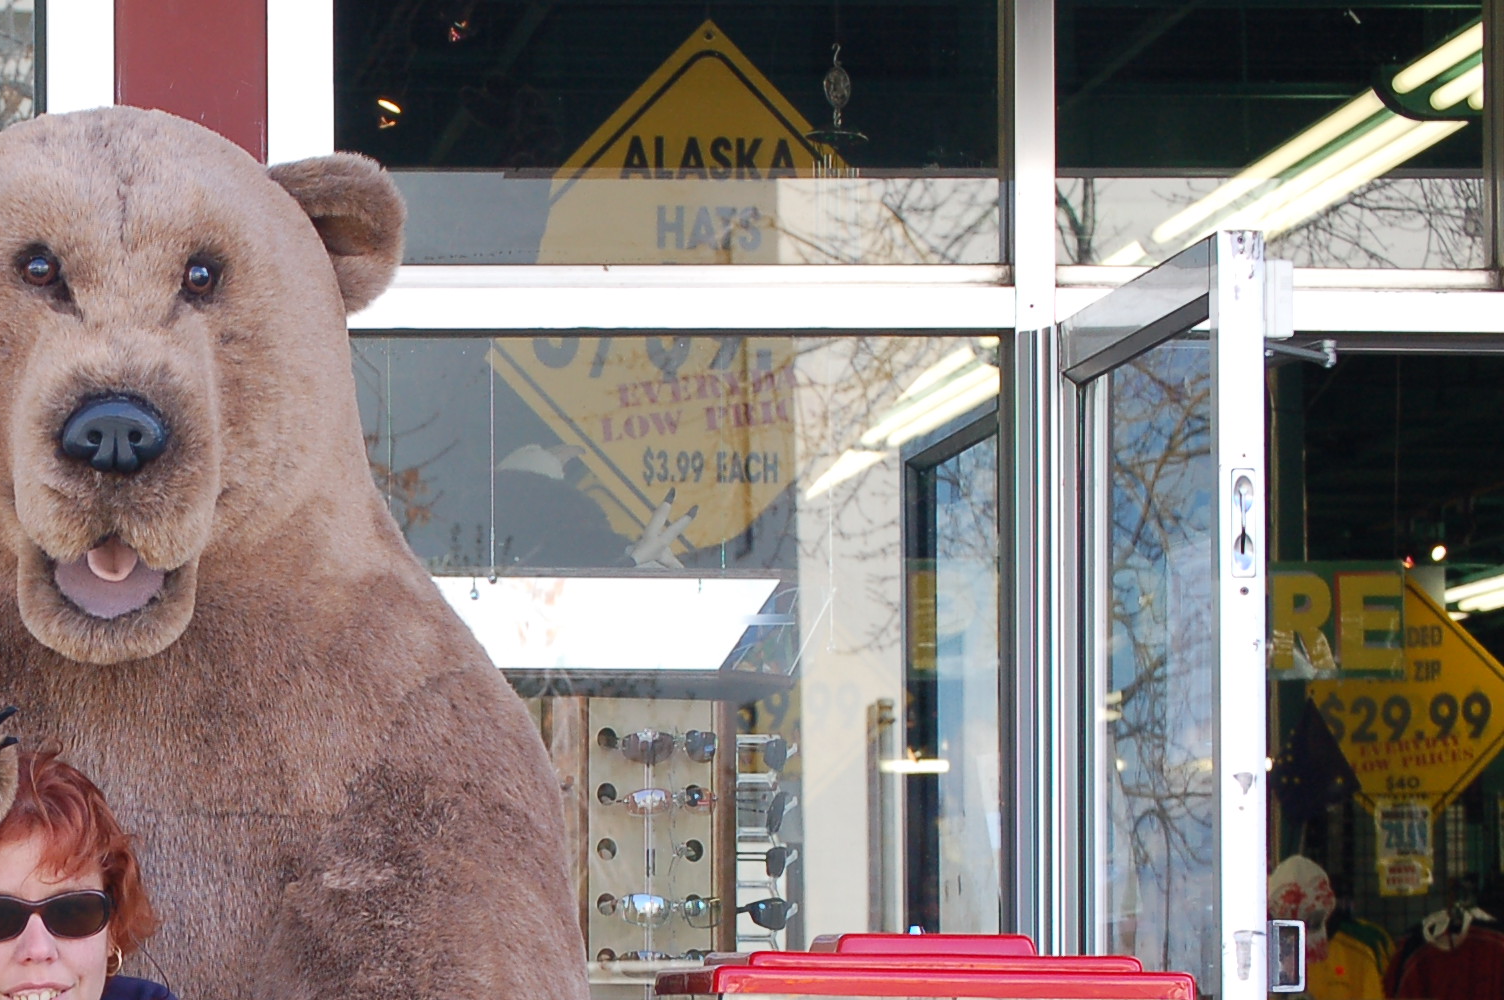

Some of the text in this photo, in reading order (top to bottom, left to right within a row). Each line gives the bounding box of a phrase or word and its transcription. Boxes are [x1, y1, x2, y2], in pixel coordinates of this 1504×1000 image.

[620, 135, 797, 180] ALASKA
[657, 205, 762, 249] HATS
[600, 410, 683, 443] LOW
[643, 447, 779, 486] $3.99 EACH
[1413, 660, 1441, 682] ZIP
[1320, 691, 1492, 743] $29.99
[1360, 734, 1459, 757] EVERYDAY
[1403, 748, 1474, 768] PRICES
